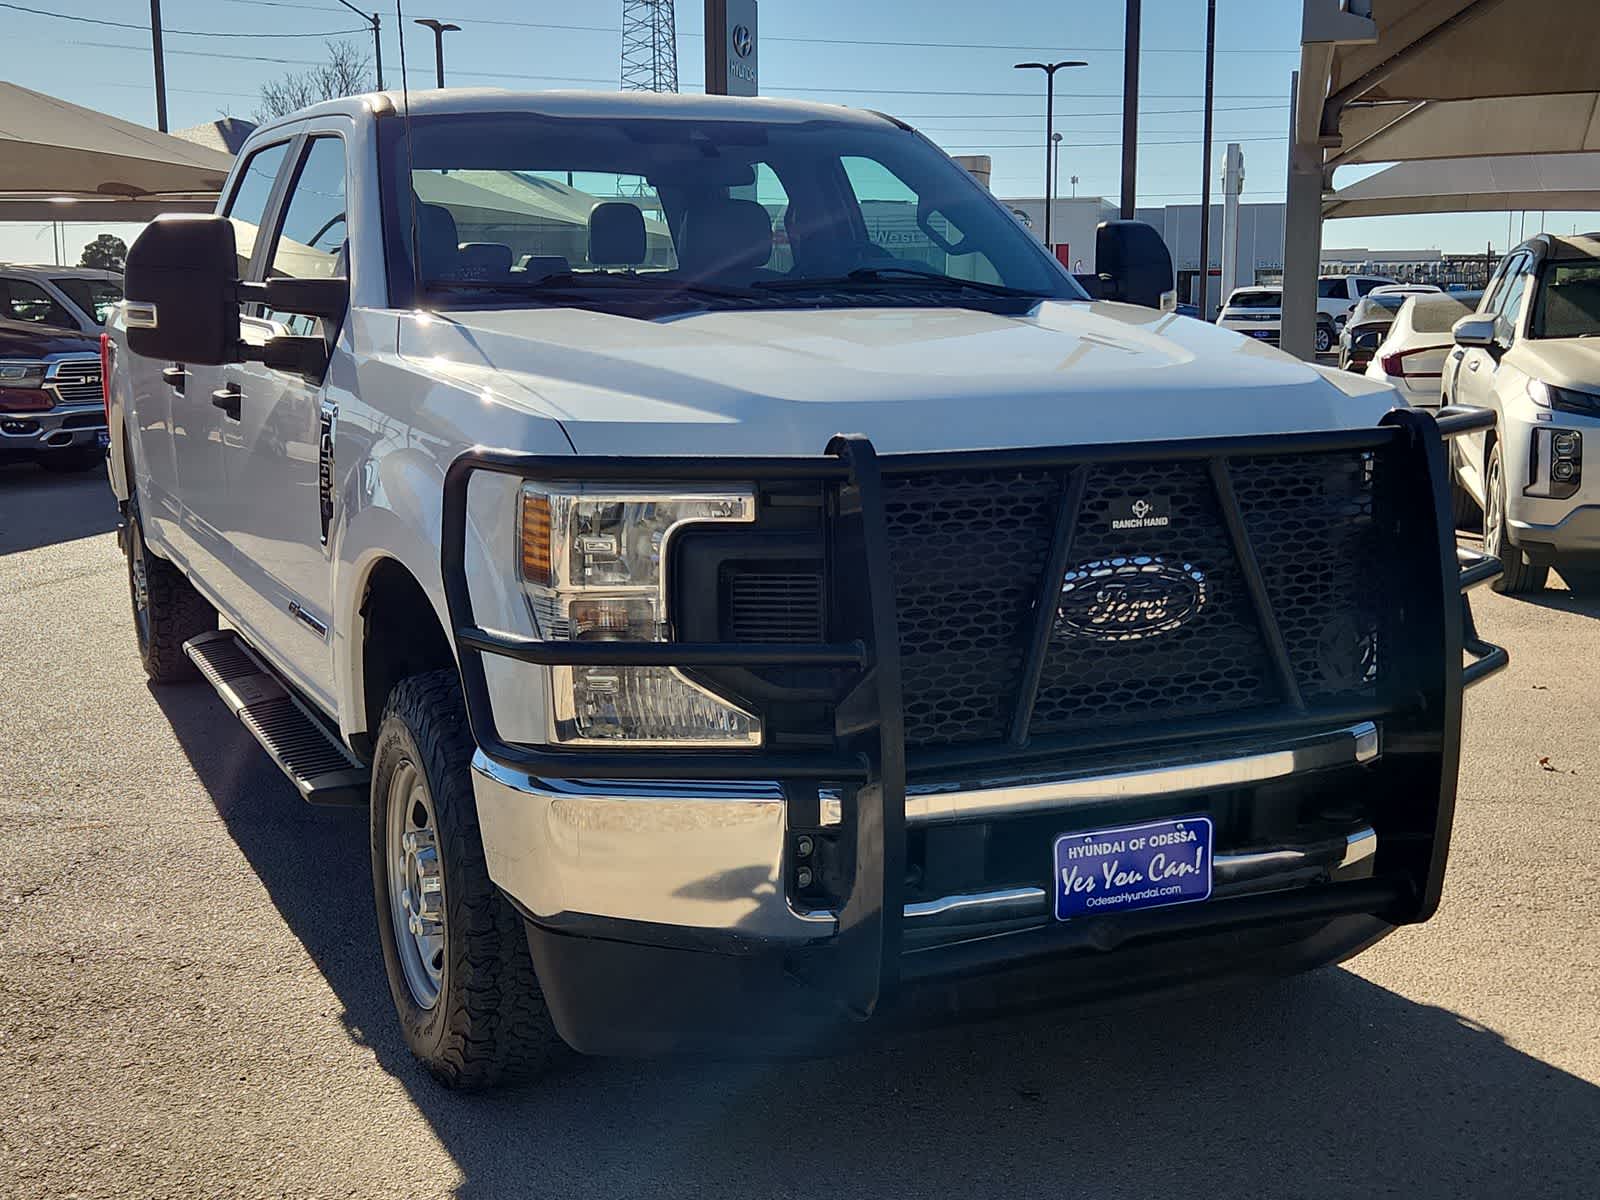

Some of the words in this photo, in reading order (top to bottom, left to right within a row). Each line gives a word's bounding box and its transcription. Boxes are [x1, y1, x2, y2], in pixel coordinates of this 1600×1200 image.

[1112, 519, 1143, 530] RANCH
[1143, 516, 1169, 528] HAND
[1068, 840, 1126, 860] HYUNDAI
[1129, 838, 1147, 852] OF
[1149, 830, 1197, 847] ODESSA
[1062, 865, 1096, 896] Yes
[1102, 859, 1144, 890] You
[1148, 846, 1204, 882] Can!
[1086, 884, 1182, 908] OdessaHyundai.com
